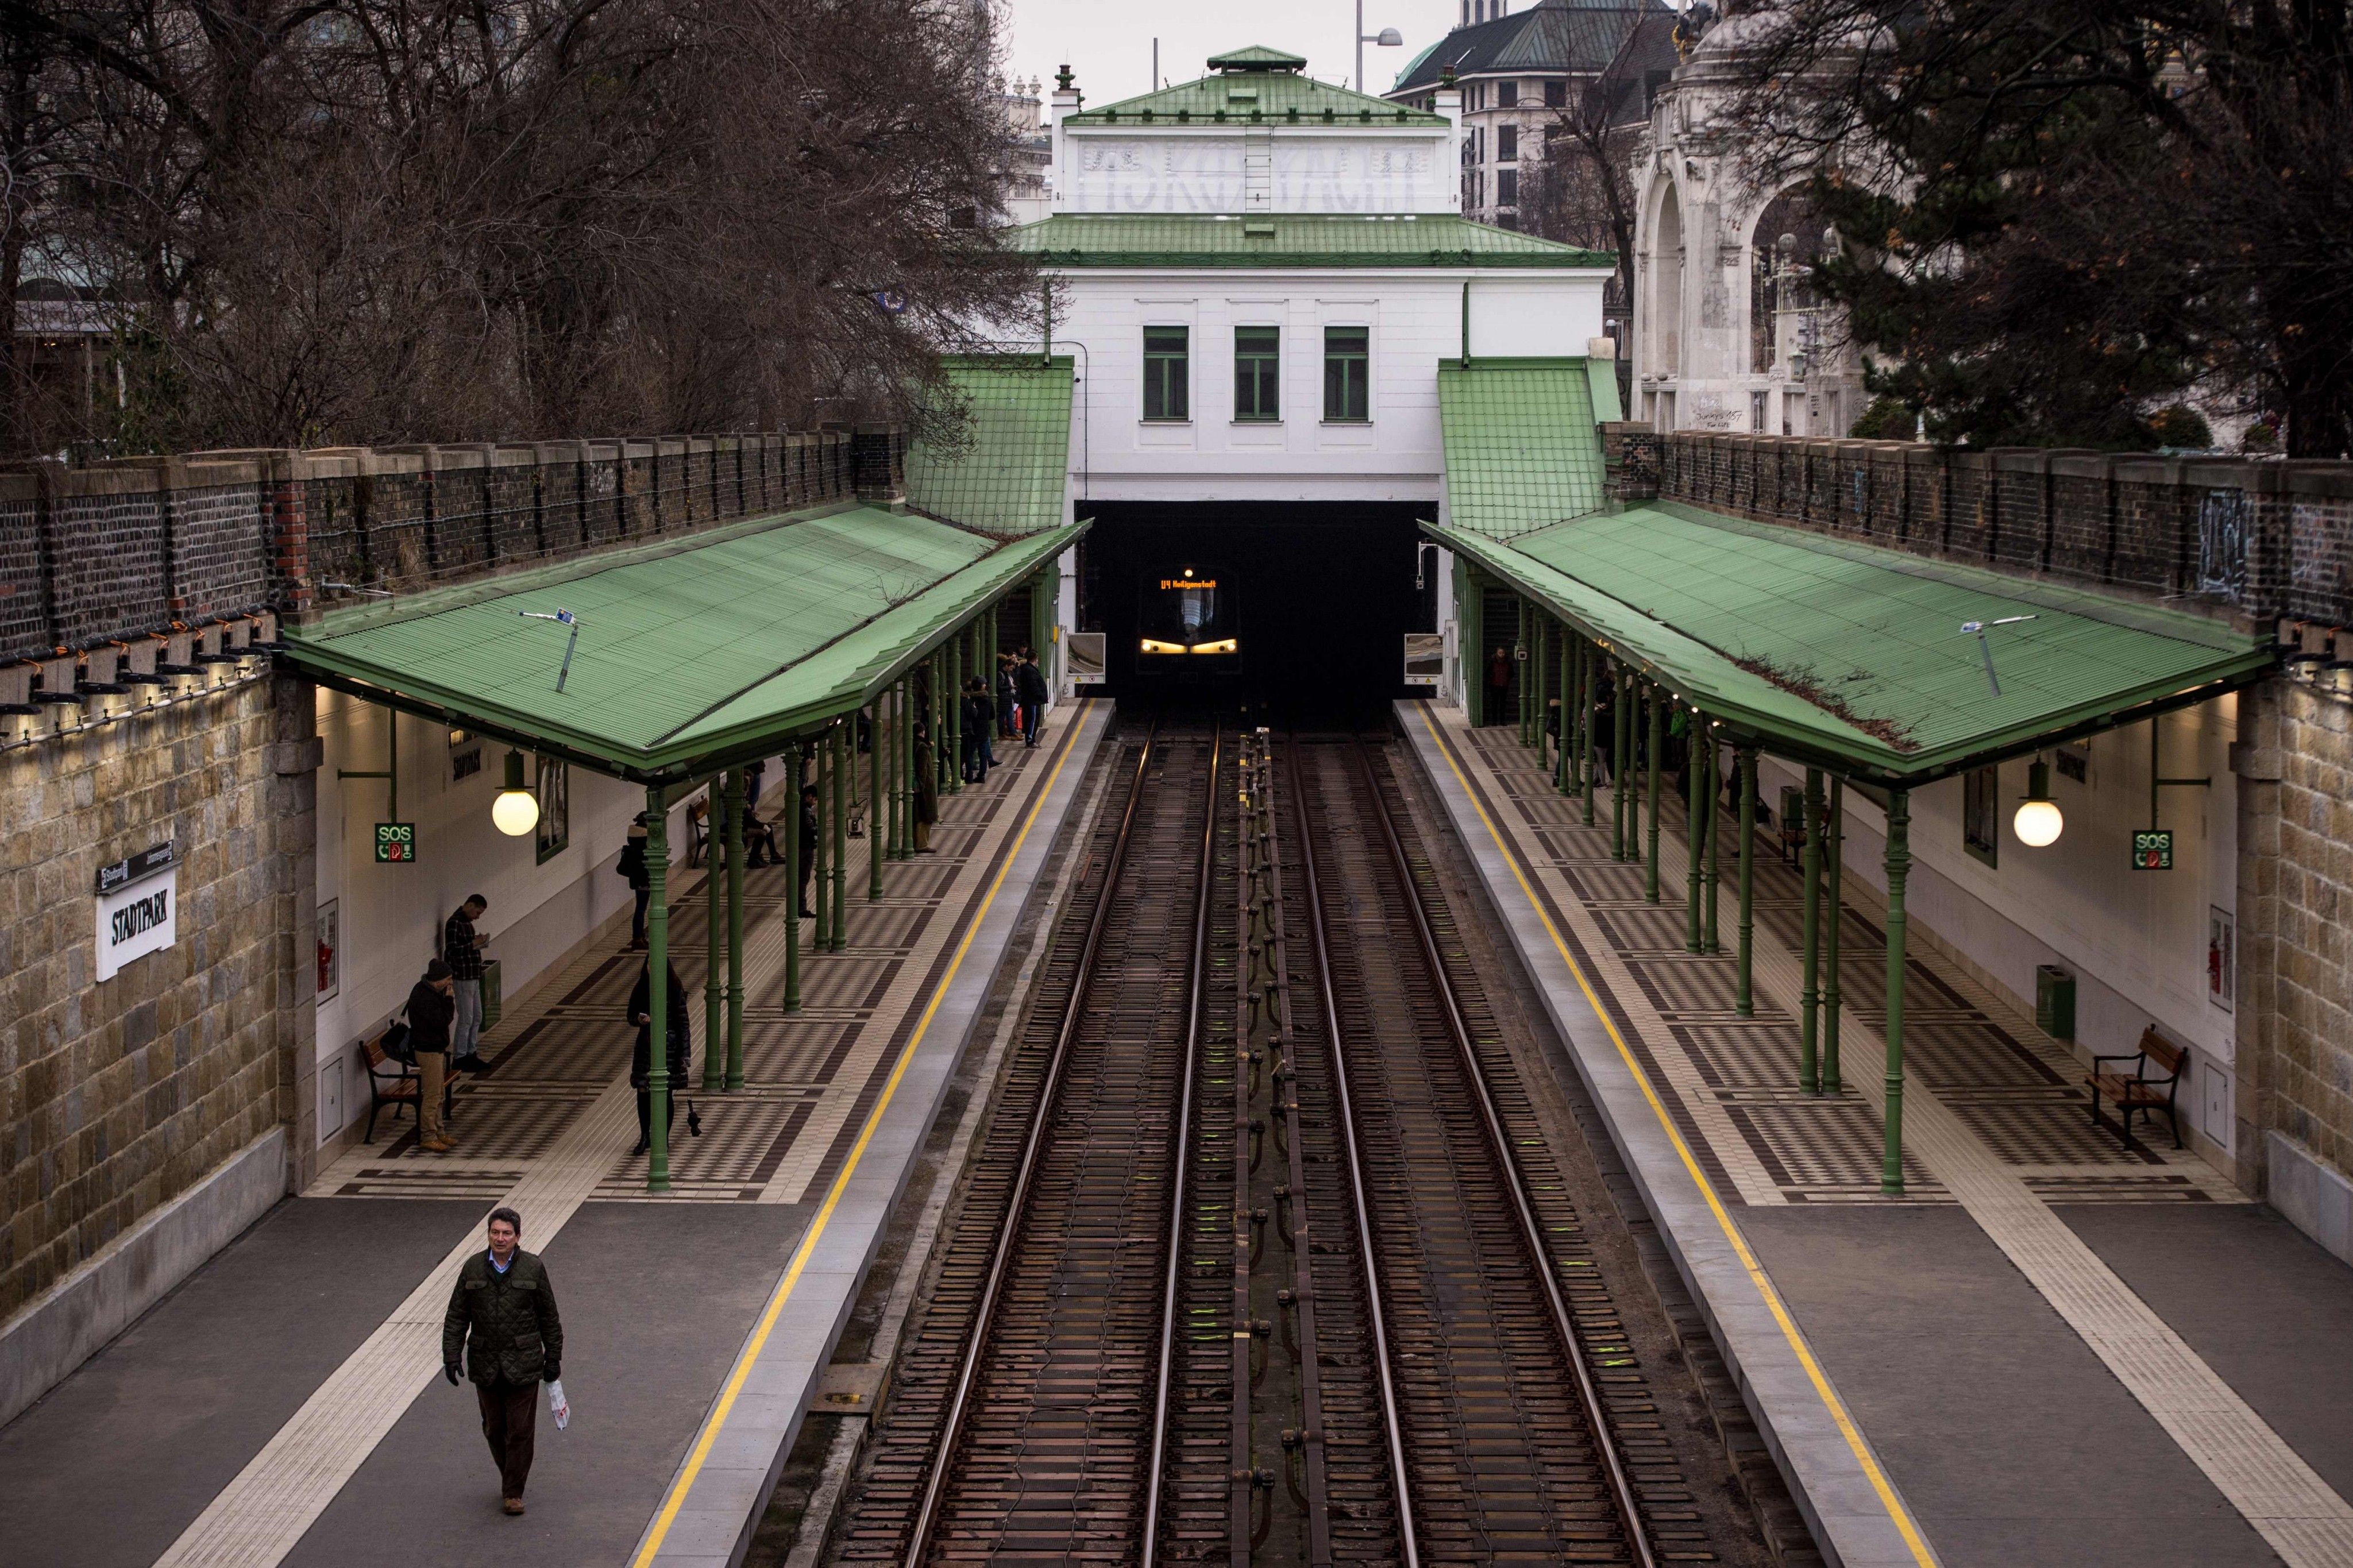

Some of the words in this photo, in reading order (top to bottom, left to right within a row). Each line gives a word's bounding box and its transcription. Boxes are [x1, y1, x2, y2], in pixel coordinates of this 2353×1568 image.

[1161, 580, 1171, 589] U4
[1172, 580, 1217, 589] Heiligenstadt
[379, 827, 411, 841] SOS
[2136, 834, 2170, 849] SOS
[111, 889, 168, 947] STADTPARK
